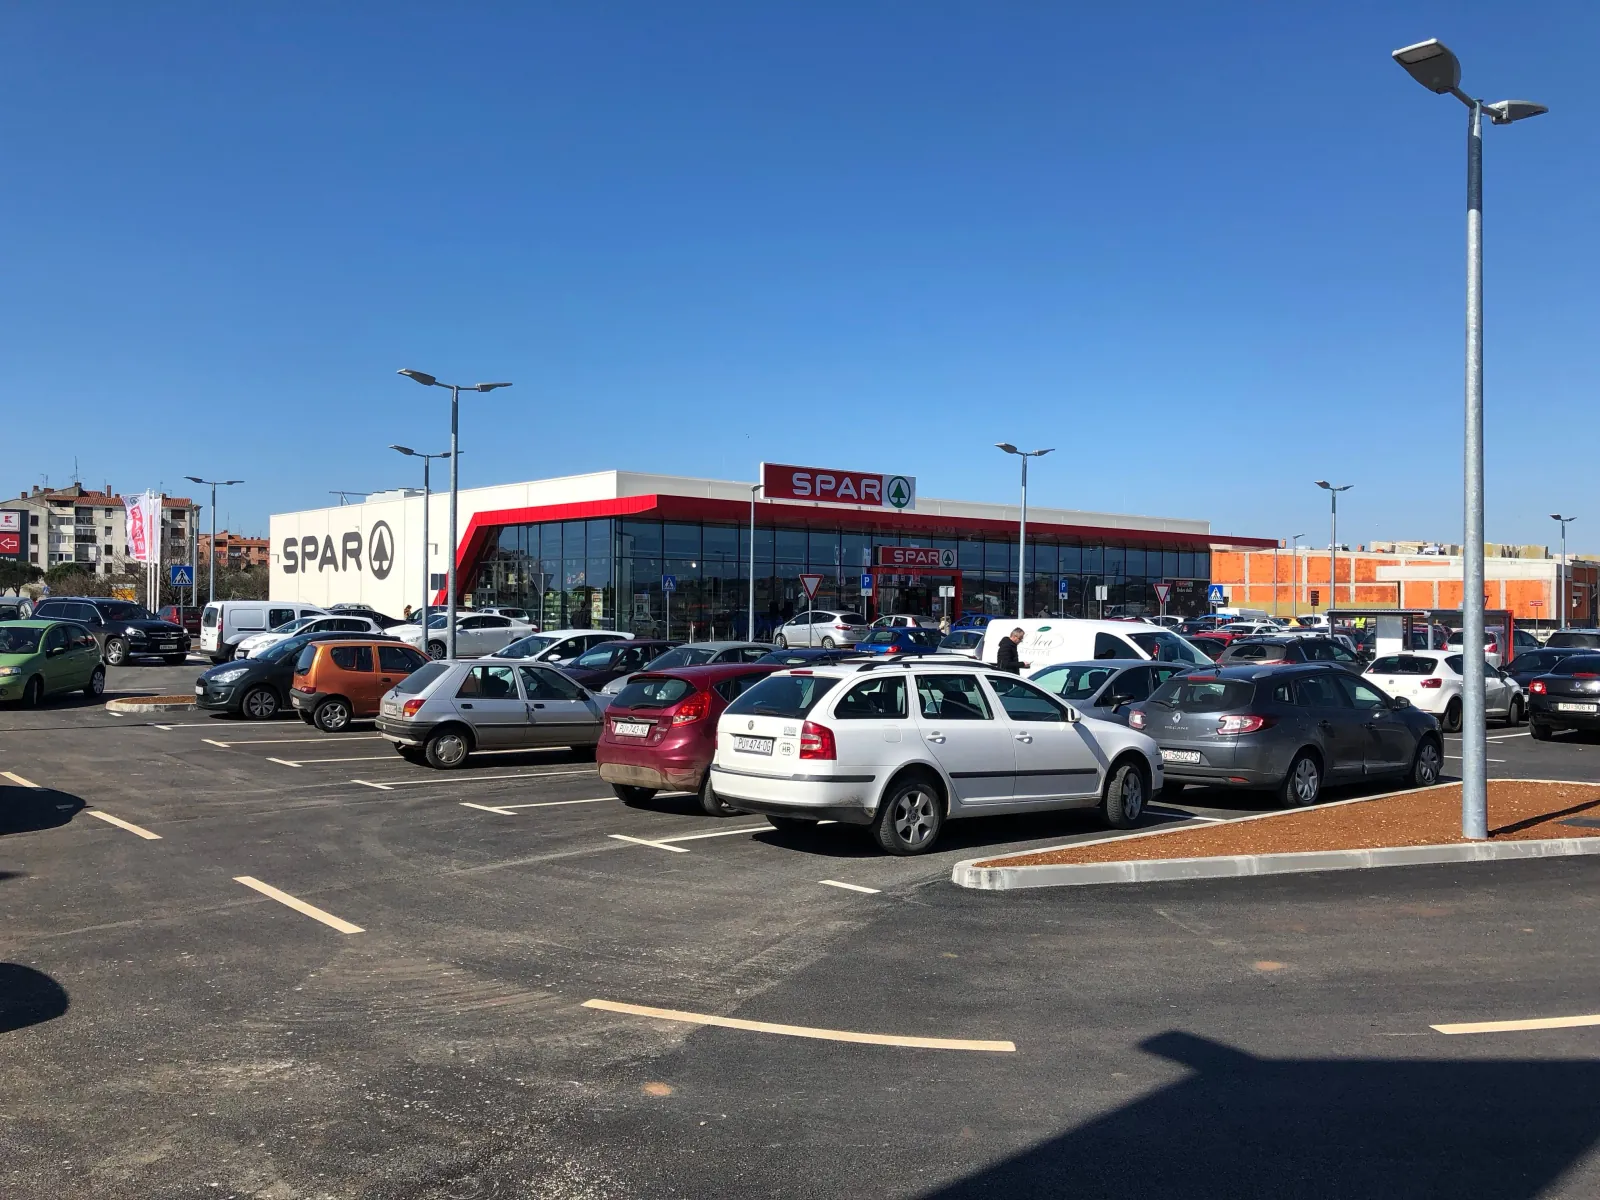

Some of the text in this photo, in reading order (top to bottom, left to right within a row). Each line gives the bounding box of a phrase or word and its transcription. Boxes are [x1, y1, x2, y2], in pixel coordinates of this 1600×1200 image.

[792, 472, 881, 501] SPAR
[283, 531, 363, 574] SPAR
[894, 550, 939, 564] SPAR
[864, 576, 870, 586] P
[1061, 582, 1066, 590] P
